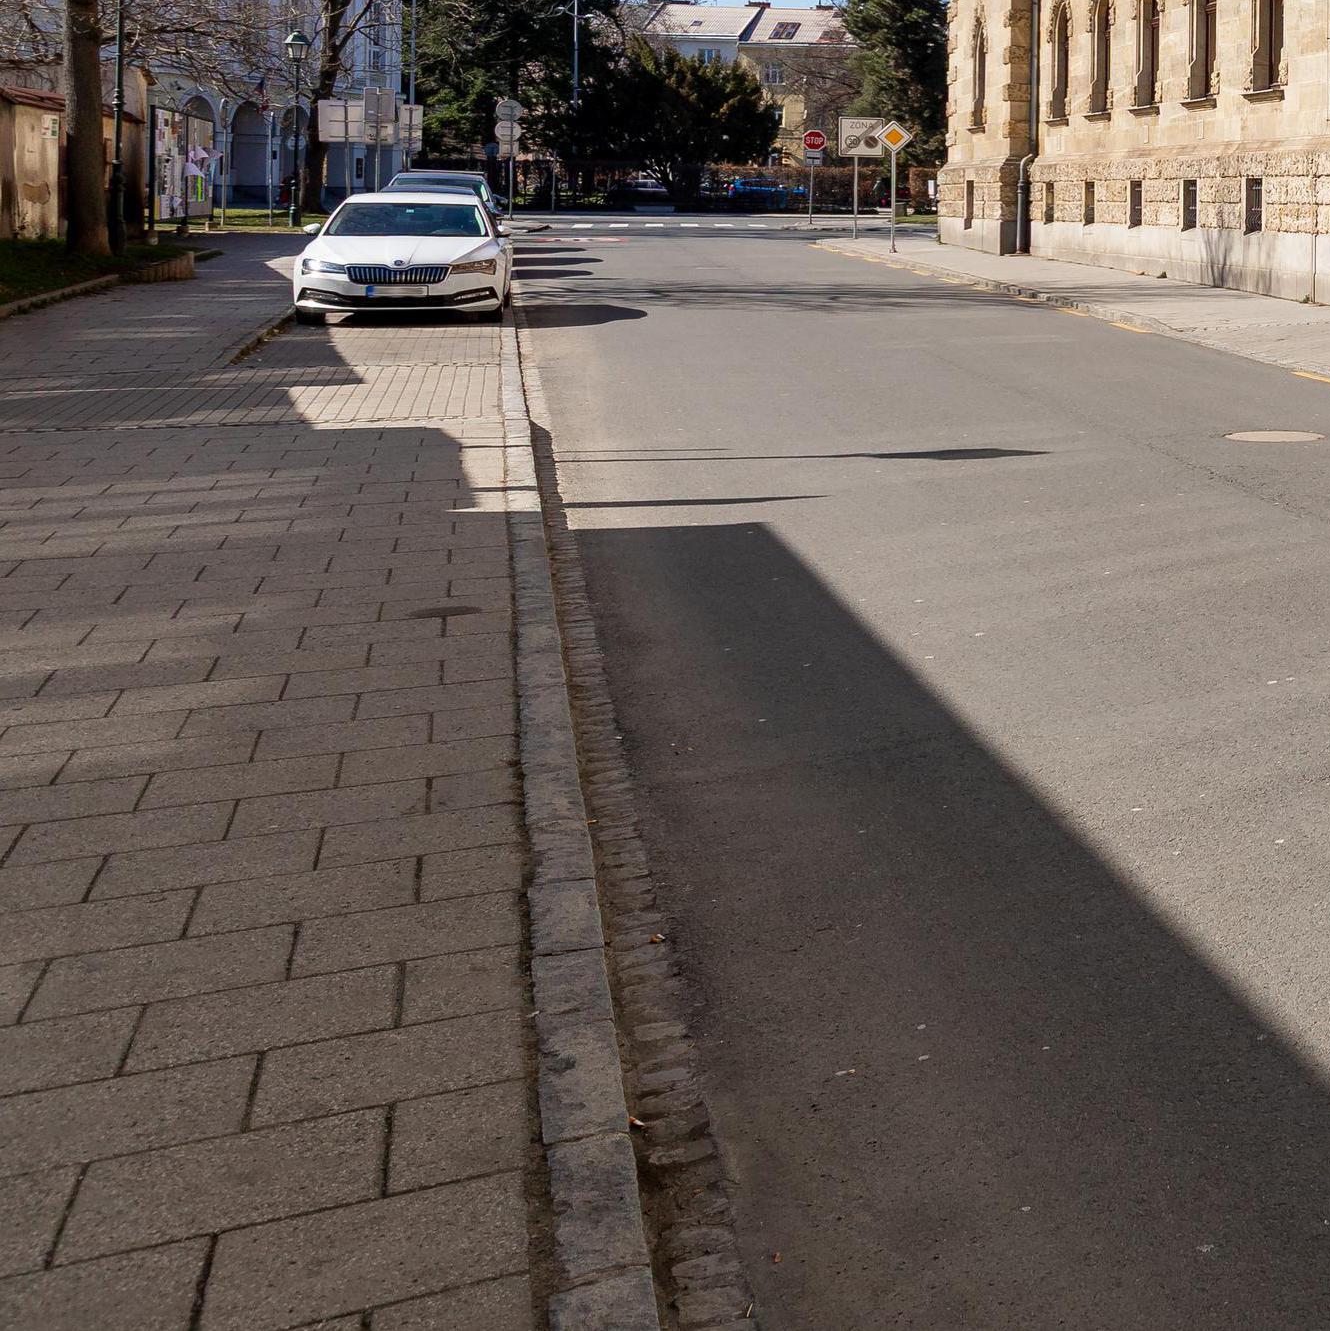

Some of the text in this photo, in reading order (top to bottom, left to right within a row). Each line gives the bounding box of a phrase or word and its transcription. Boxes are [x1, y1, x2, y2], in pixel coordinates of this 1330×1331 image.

[850, 121, 874, 130] ZONA
[805, 136, 824, 145] STOP
[848, 136, 858, 146] 30
